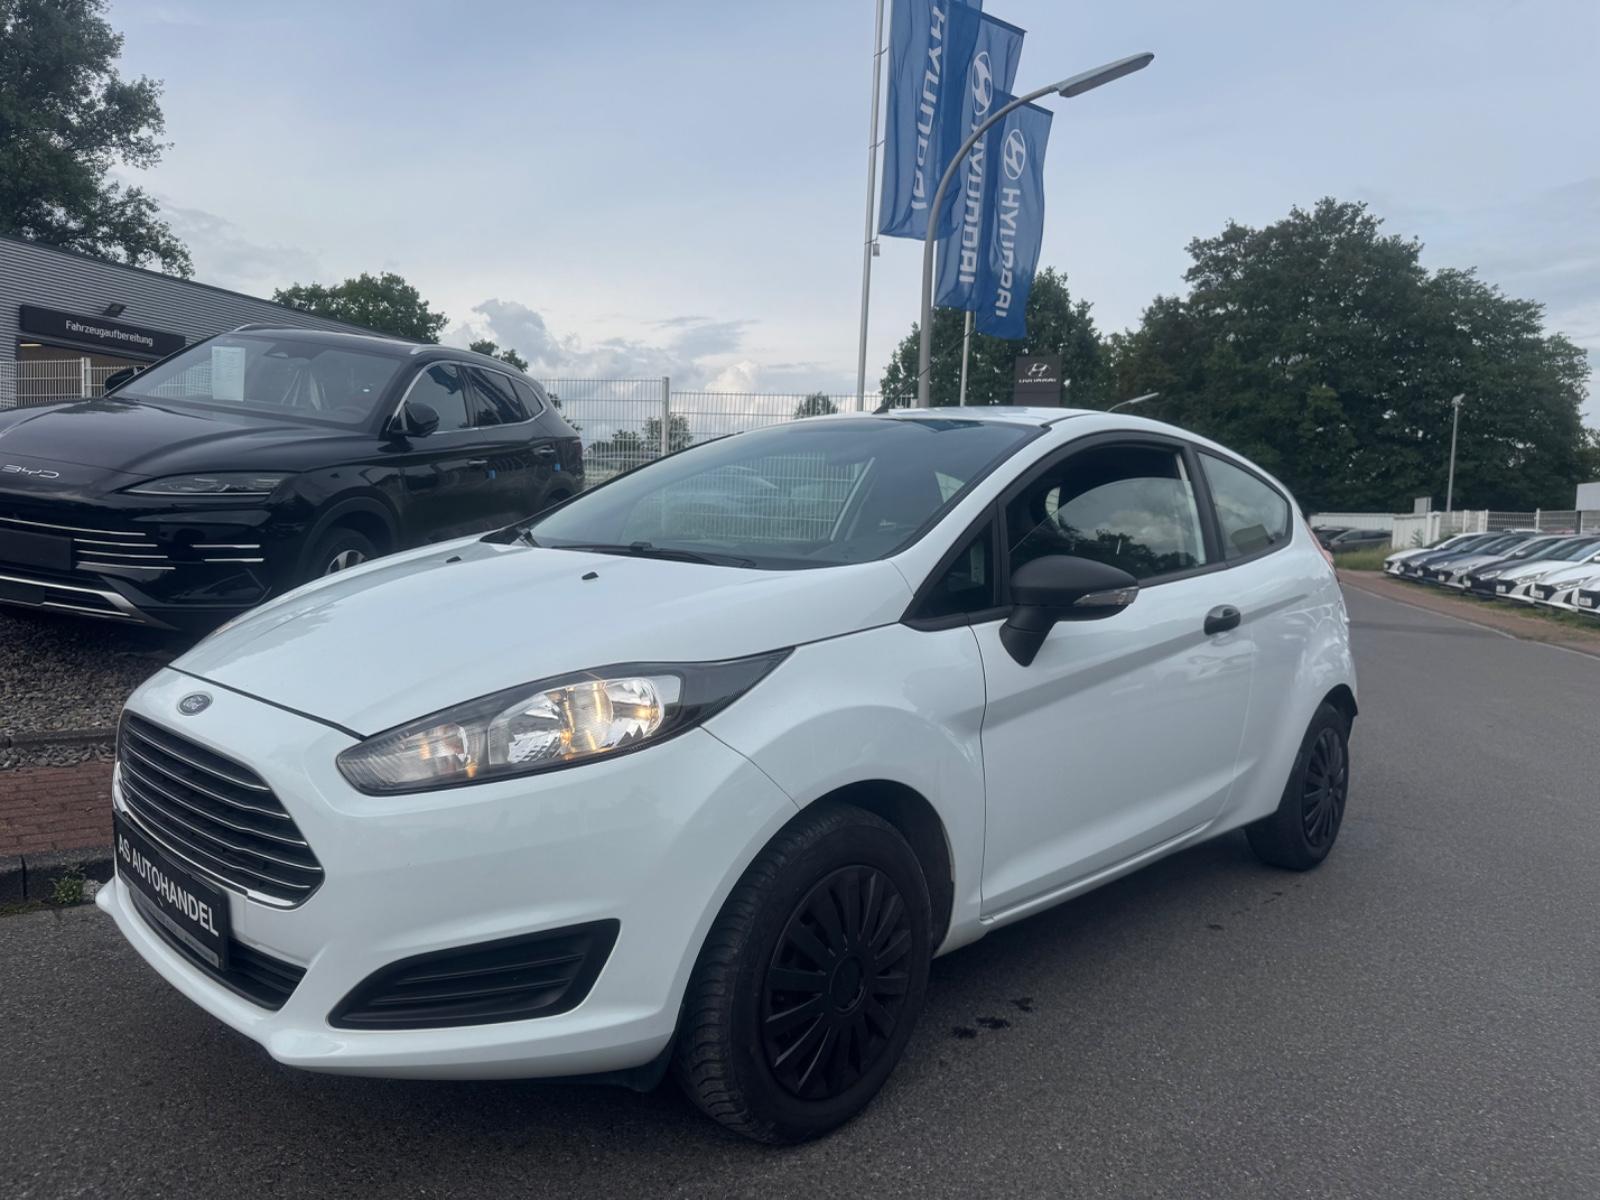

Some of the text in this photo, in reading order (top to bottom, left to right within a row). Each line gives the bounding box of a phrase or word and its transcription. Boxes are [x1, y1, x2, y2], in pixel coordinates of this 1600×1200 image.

[911, 5, 946, 210] HYUNDAI
[995, 187, 1021, 317] HYUNDAI
[65, 319, 154, 347] Fahrzeugaufbereitung
[1, 463, 60, 479] BYD
[118, 833, 219, 937] AS AUTOHANDEL
